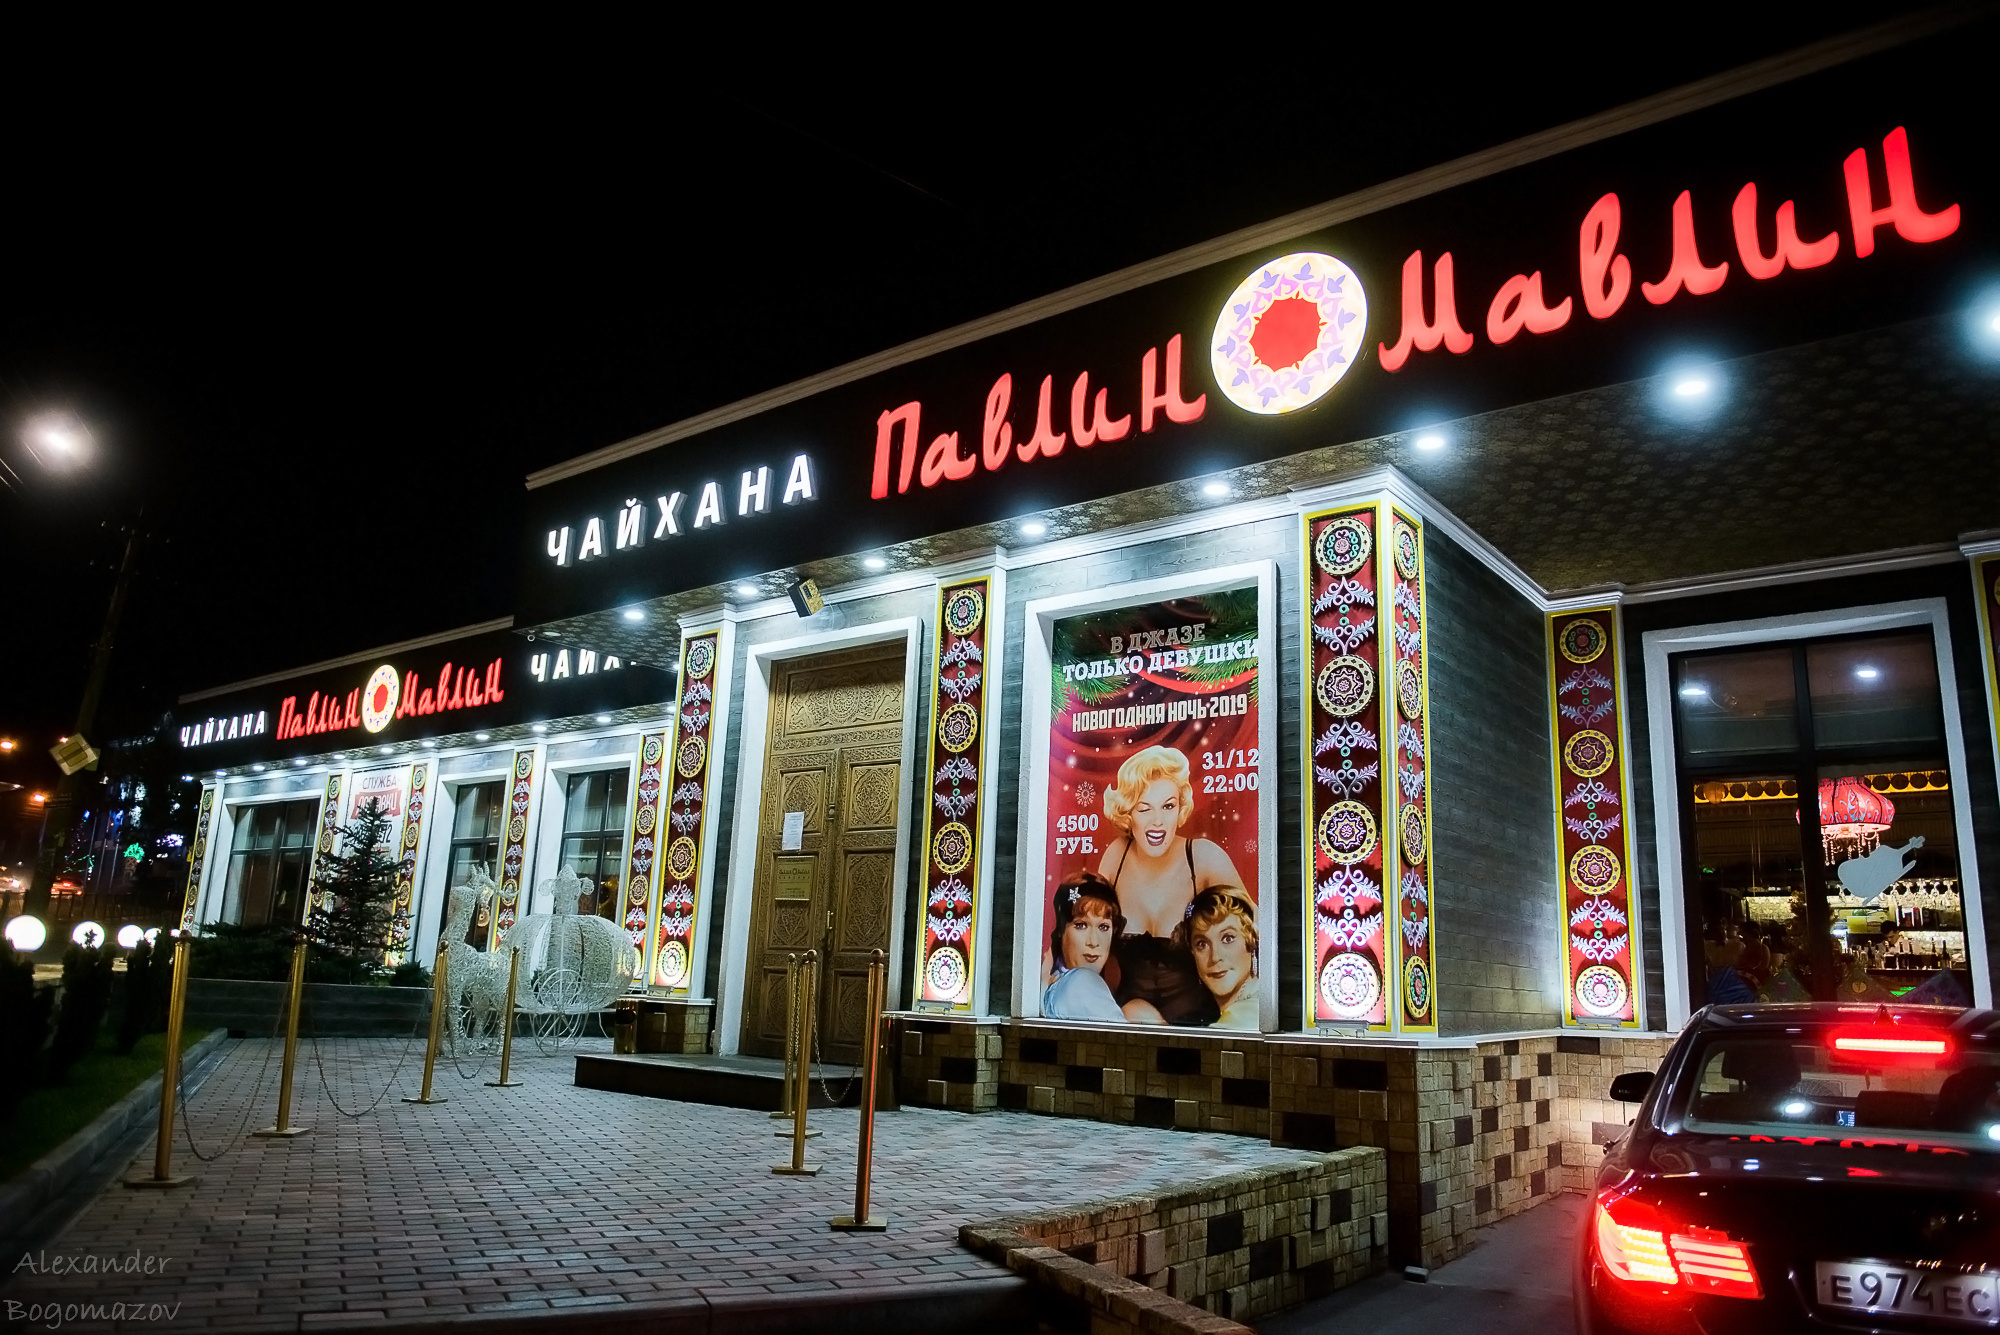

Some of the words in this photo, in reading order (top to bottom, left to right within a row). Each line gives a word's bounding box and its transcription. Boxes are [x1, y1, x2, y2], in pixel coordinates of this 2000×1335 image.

[547, 454, 816, 567] ЧАЙХАНА
[871, 333, 1206, 499] Павлин
[1378, 126, 1960, 372] Мавлин
[1110, 636, 1123, 653] В
[1127, 623, 1206, 653] ДЖАЗЕ
[1062, 655, 1144, 683] ТОЛЬКО
[1147, 639, 1259, 673] ДЕВУШКИ
[180, 711, 268, 747] ЧАЙХАНА
[276, 688, 361, 740] Павлин
[396, 657, 504, 719] Мавлин
[1072, 703, 1166, 733] НОВОГОДНЯЯ
[1168, 699, 1207, 722] НОЧЬ
[1209, 694, 1248, 718] 2019
[1202, 748, 1259, 770] 31/12
[362, 775, 397, 790] СЛУЖБА
[1202, 772, 1259, 793] 22:00
[356, 792, 398, 815] ДОСАВКИ
[1056, 814, 1099, 833] 4500
[1056, 837, 1099, 854] РУБ.
